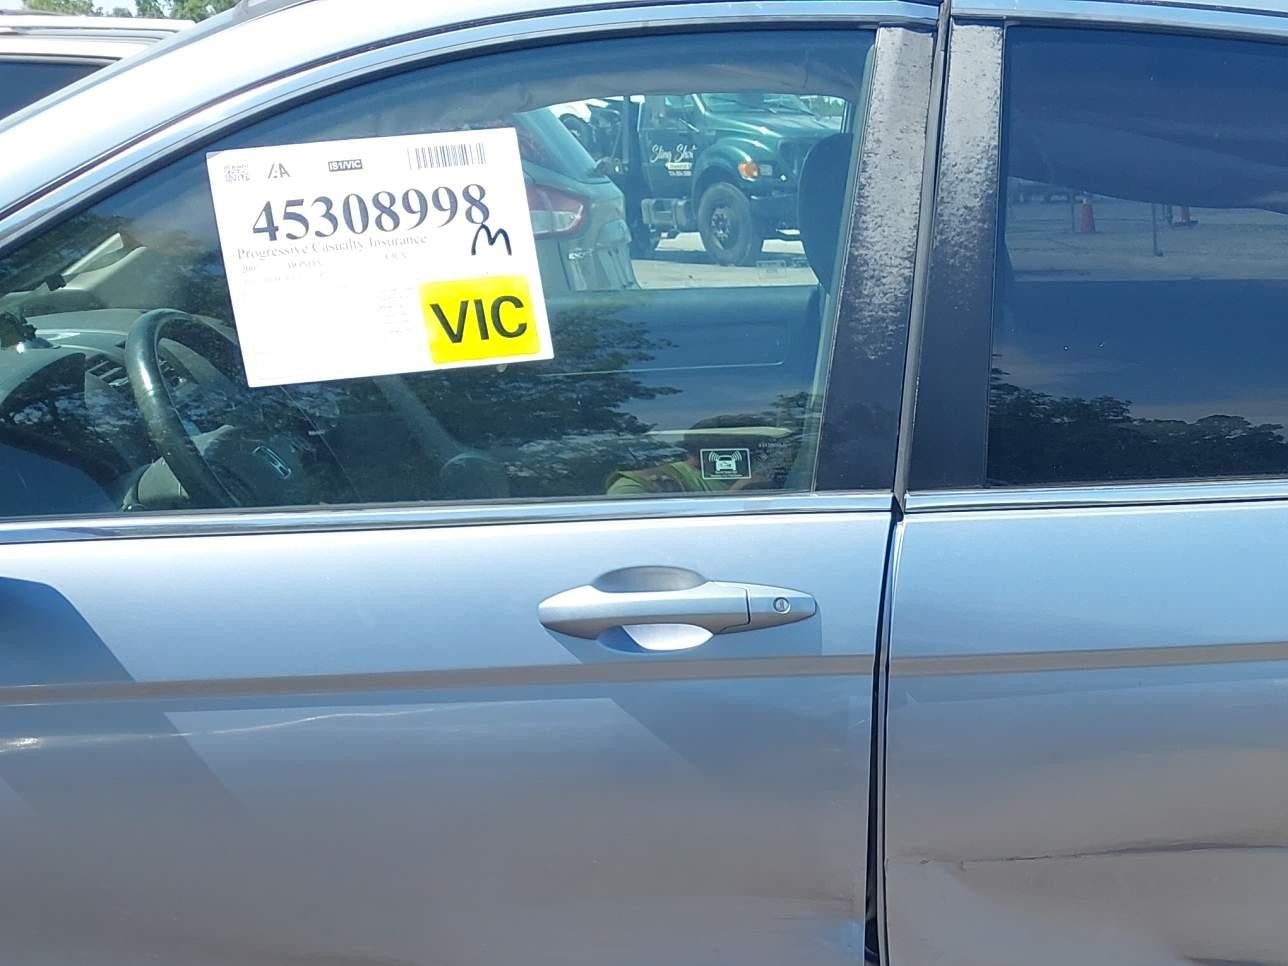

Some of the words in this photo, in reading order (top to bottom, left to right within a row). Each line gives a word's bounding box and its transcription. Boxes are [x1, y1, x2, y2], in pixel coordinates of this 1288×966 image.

[252, 183, 491, 242] 45308998
[235, 243, 309, 261] Progressive
[312, 239, 363, 254] Casualty
[368, 234, 428, 249] Insurance
[430, 294, 528, 344] VIC
